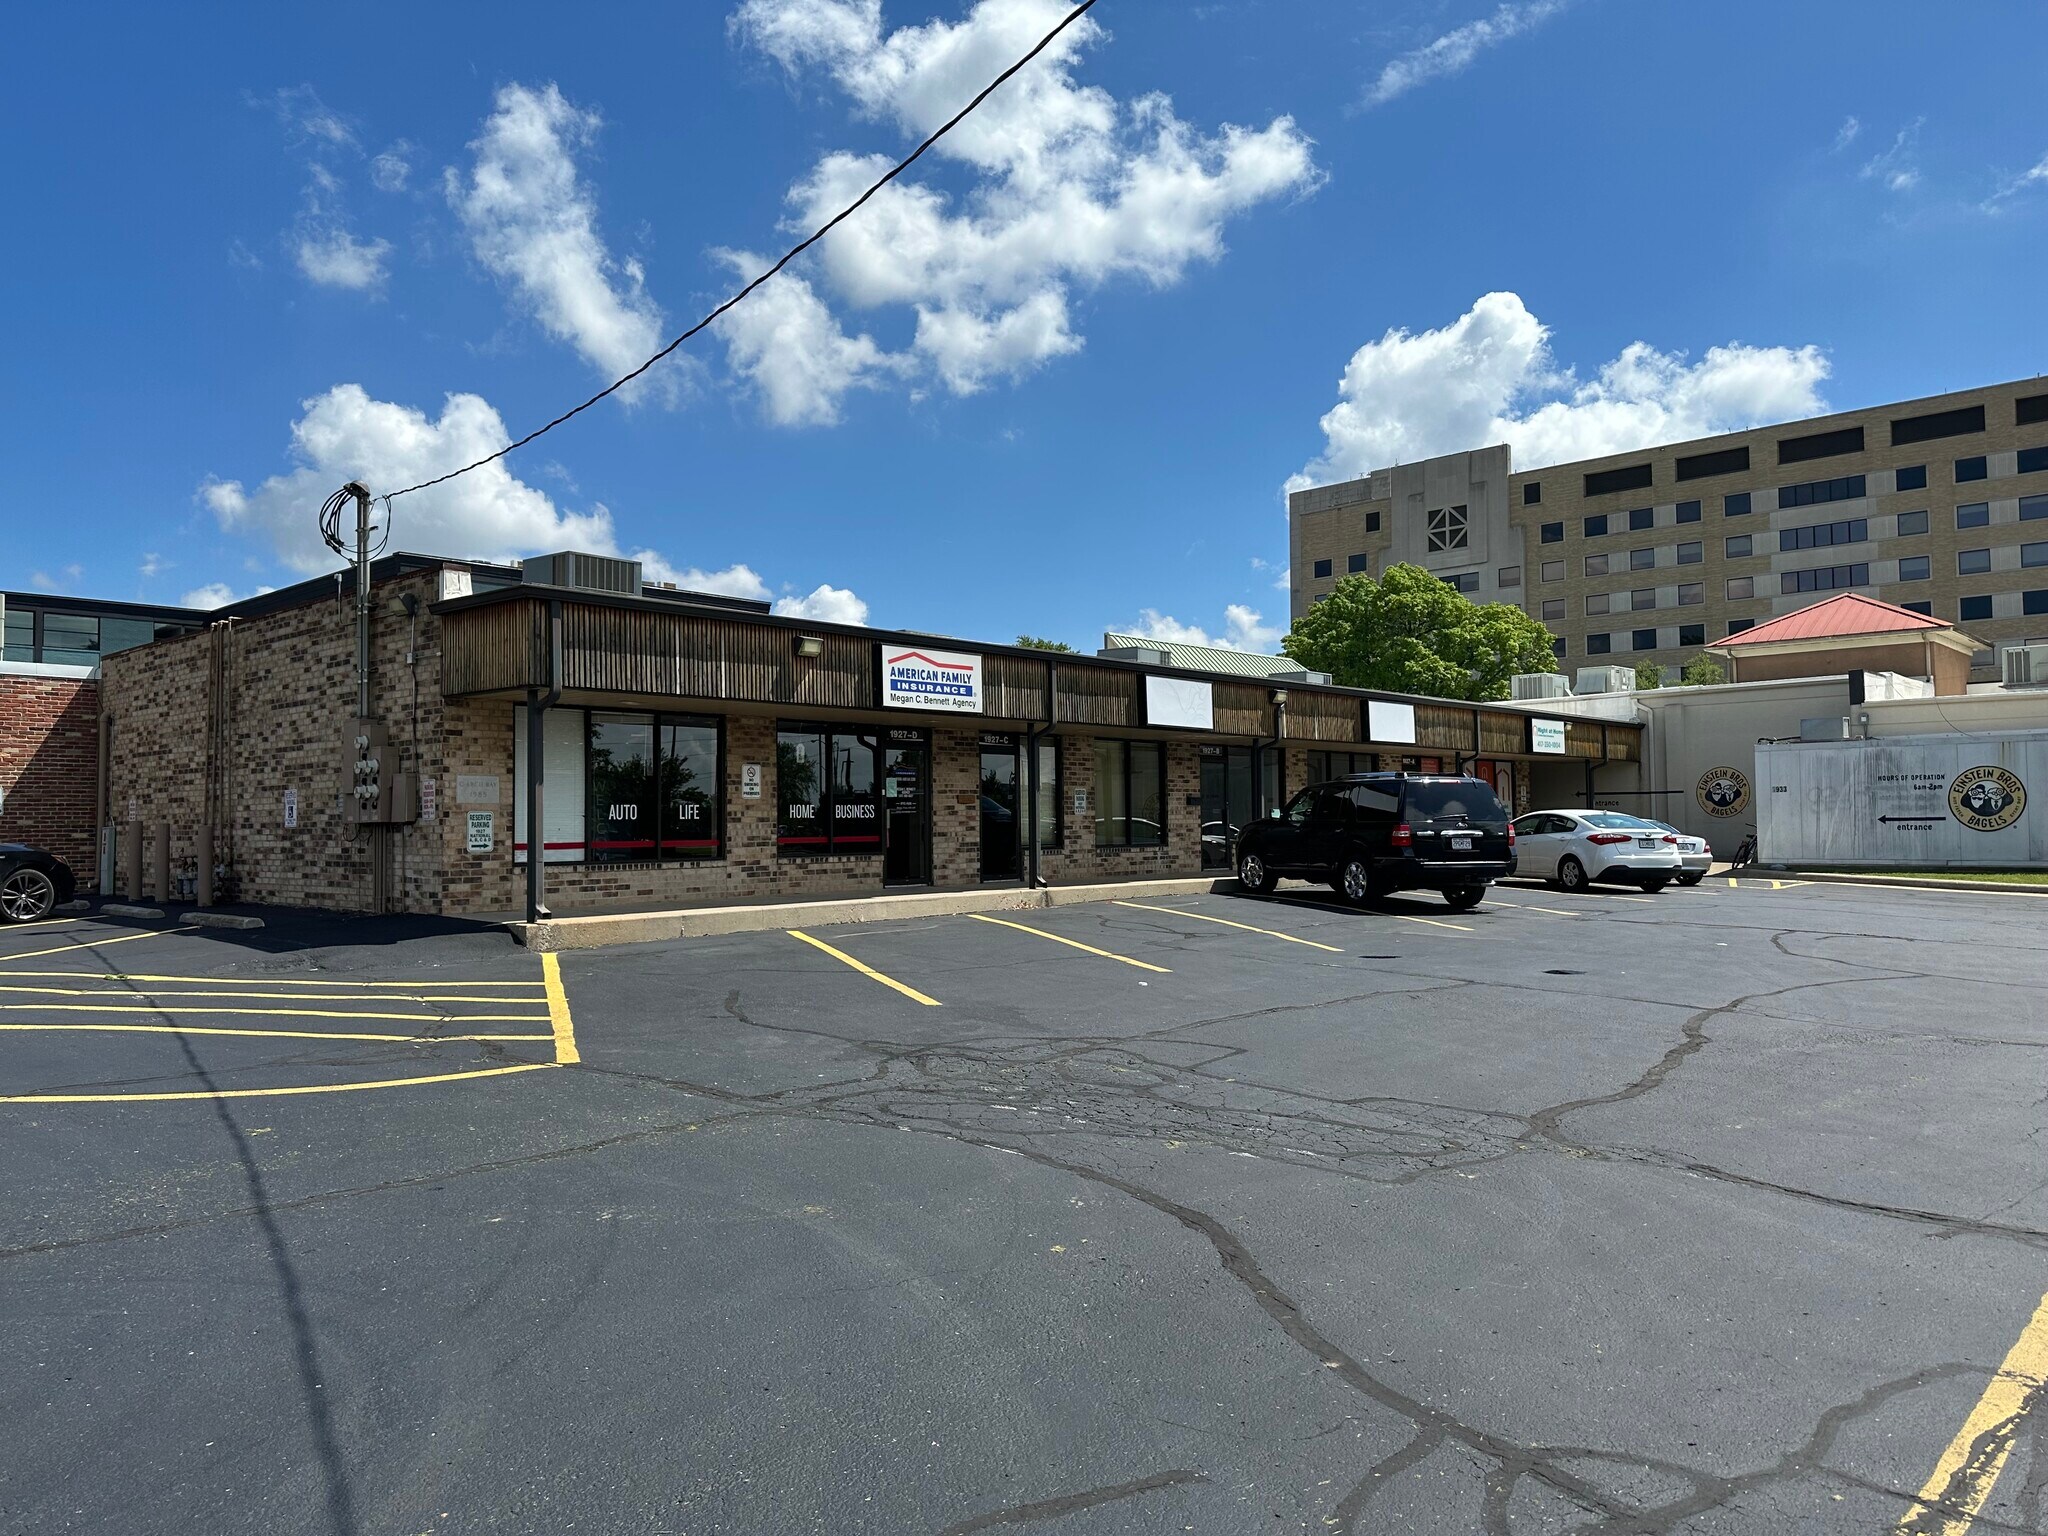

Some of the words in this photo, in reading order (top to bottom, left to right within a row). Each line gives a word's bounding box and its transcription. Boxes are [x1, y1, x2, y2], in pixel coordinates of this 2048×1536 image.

[890, 666, 938, 682] AMERICAN
[941, 672, 972, 684] FAMILY
[898, 682, 966, 694] INSURANCE
[890, 693, 914, 704] Megan
[916, 695, 922, 704] C.
[924, 696, 950, 706] Bennett
[952, 698, 976, 709] Agency
[890, 730, 918, 739] 1927-D
[984, 736, 1008, 744] 1927-C
[1699, 770, 1727, 790] EINSTEIN
[1730, 772, 1746, 789] BROS
[1954, 769, 1994, 794] EINSTEIN
[1997, 772, 2021, 793] BROS
[608, 804, 638, 820] AUTO
[680, 804, 700, 820] LIFE
[790, 804, 815, 818] HOME
[835, 804, 875, 818] BUSINESS
[1710, 806, 1738, 816] BAGELS
[1967, 815, 2007, 828] BAGELS
